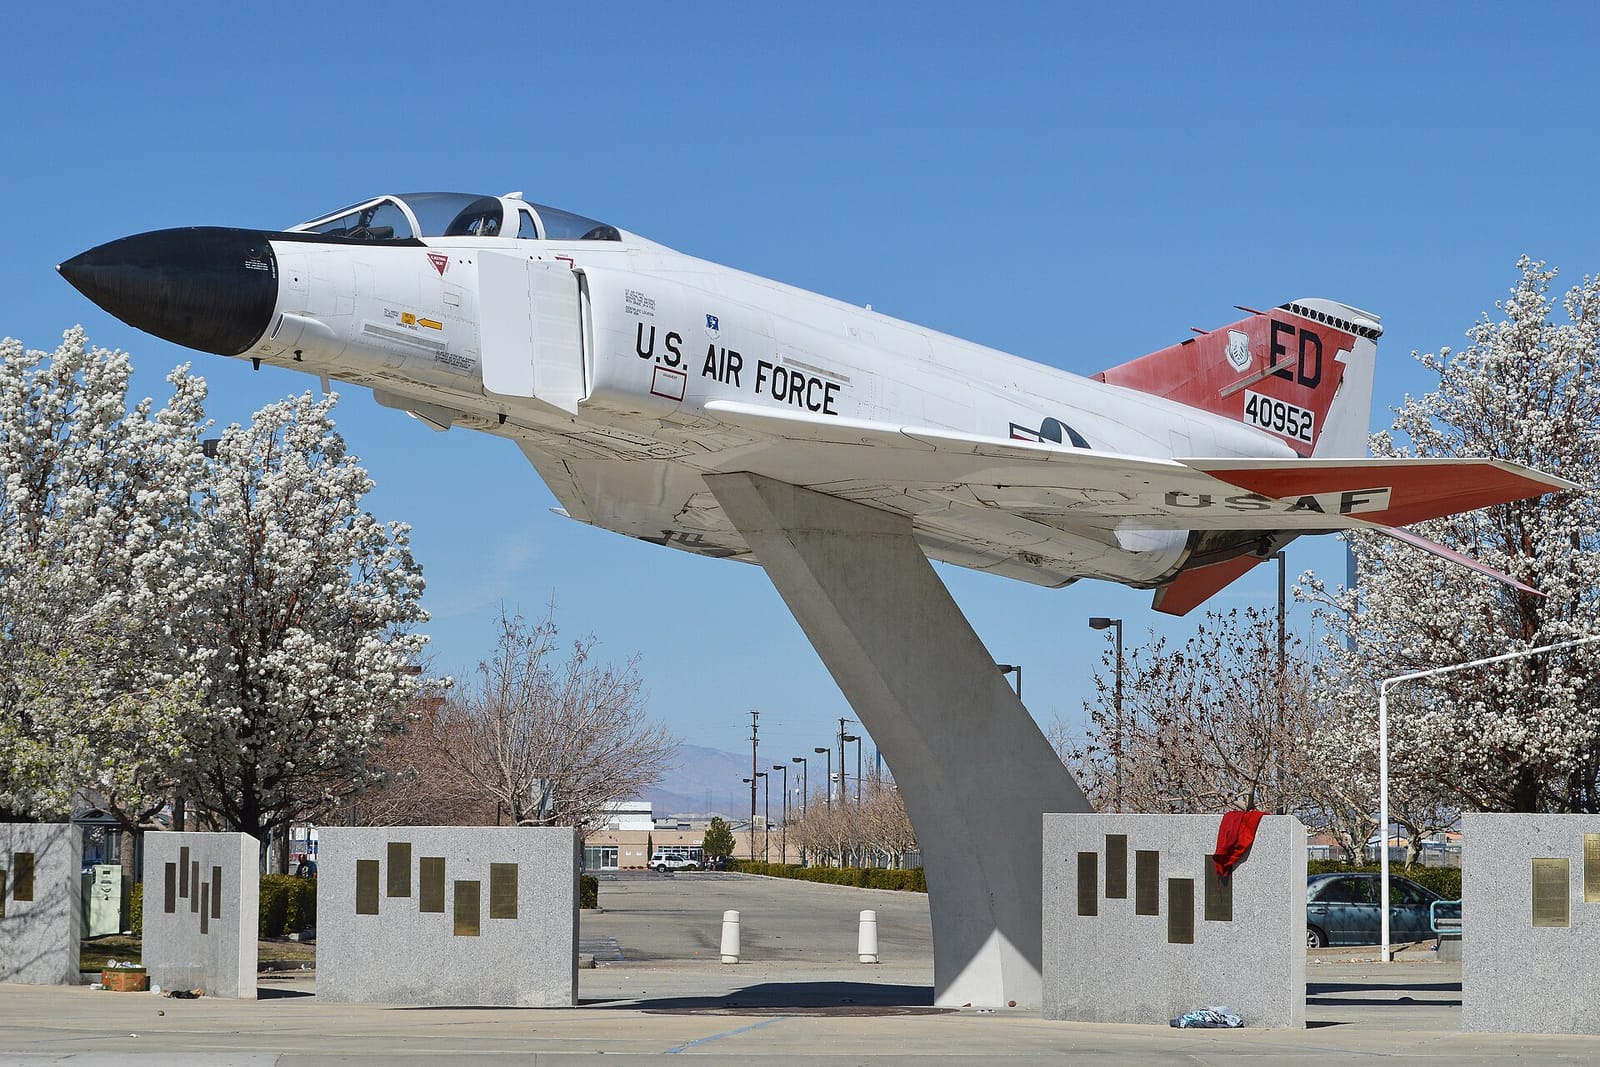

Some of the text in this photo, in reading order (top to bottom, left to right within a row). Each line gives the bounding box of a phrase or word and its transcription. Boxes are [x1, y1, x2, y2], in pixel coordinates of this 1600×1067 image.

[636, 322, 841, 416] U.S. AIR FORCE
[1270, 318, 1323, 390] ED
[1245, 394, 1313, 442] 40952
[1165, 487, 1389, 514] USAF
